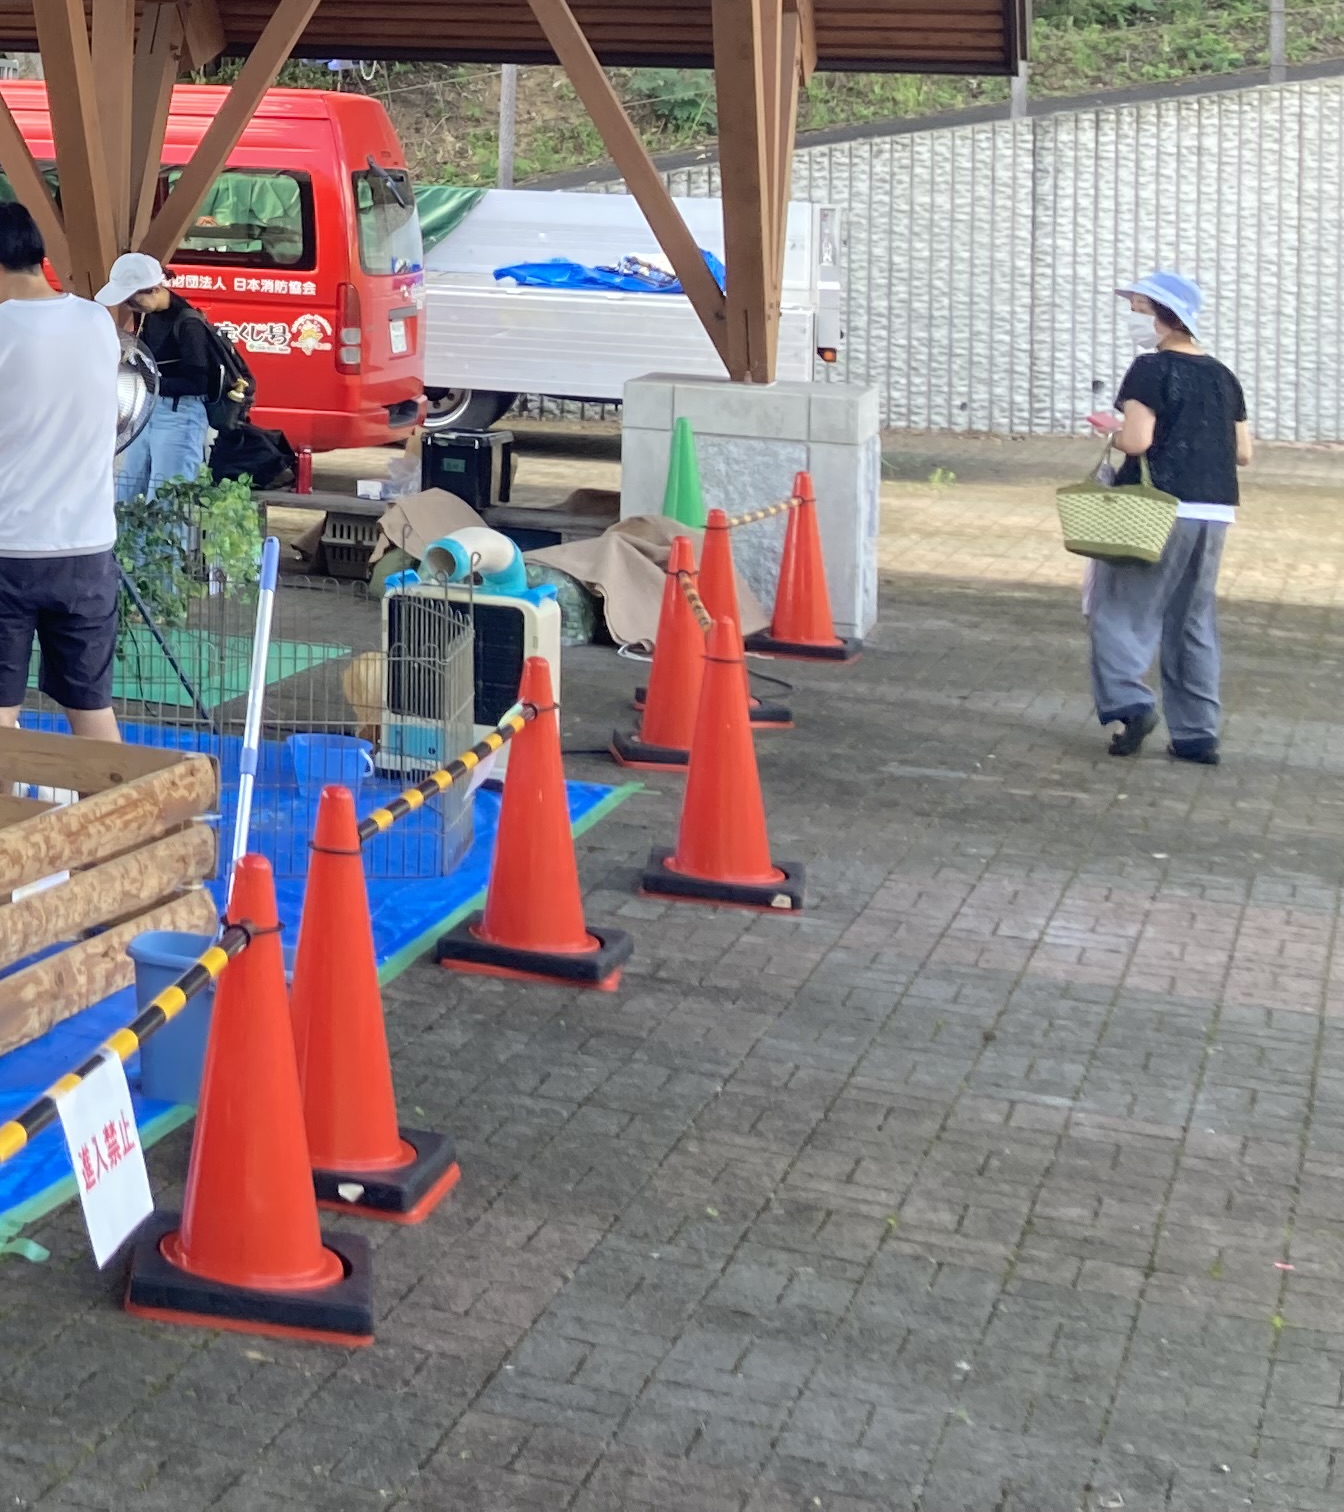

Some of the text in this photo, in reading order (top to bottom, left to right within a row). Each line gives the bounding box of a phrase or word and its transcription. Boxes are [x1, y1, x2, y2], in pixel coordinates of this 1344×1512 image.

[233, 277, 317, 296] 日本消防協会
[77, 1108, 136, 1193] 進入禁止
